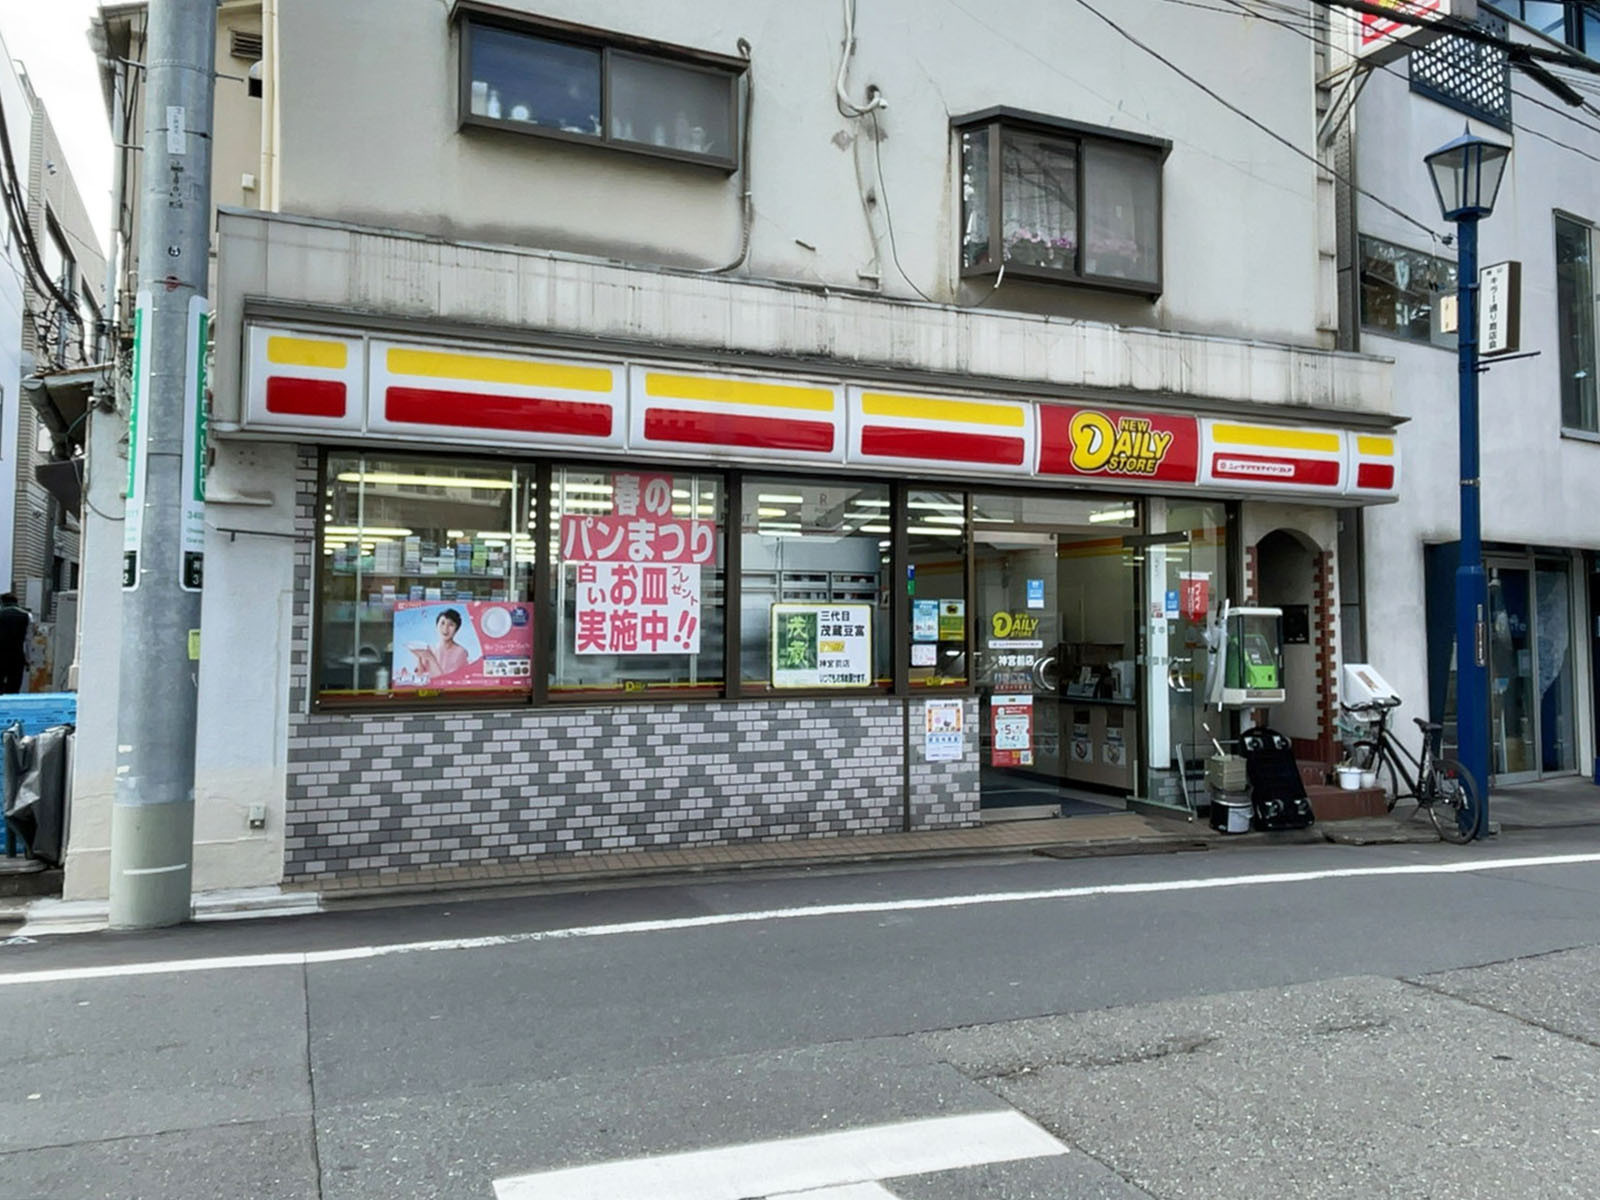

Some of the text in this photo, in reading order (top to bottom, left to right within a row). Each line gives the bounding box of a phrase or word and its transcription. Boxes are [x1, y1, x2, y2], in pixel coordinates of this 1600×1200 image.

[1070, 411, 1172, 470] DAILY
[1119, 419, 1149, 432] NEW
[1107, 456, 1156, 473] STORE
[615, 474, 671, 516] 春の
[563, 516, 714, 563] パンまつり
[577, 609, 698, 652] 実施中!!
[820, 611, 850, 622] 三代目
